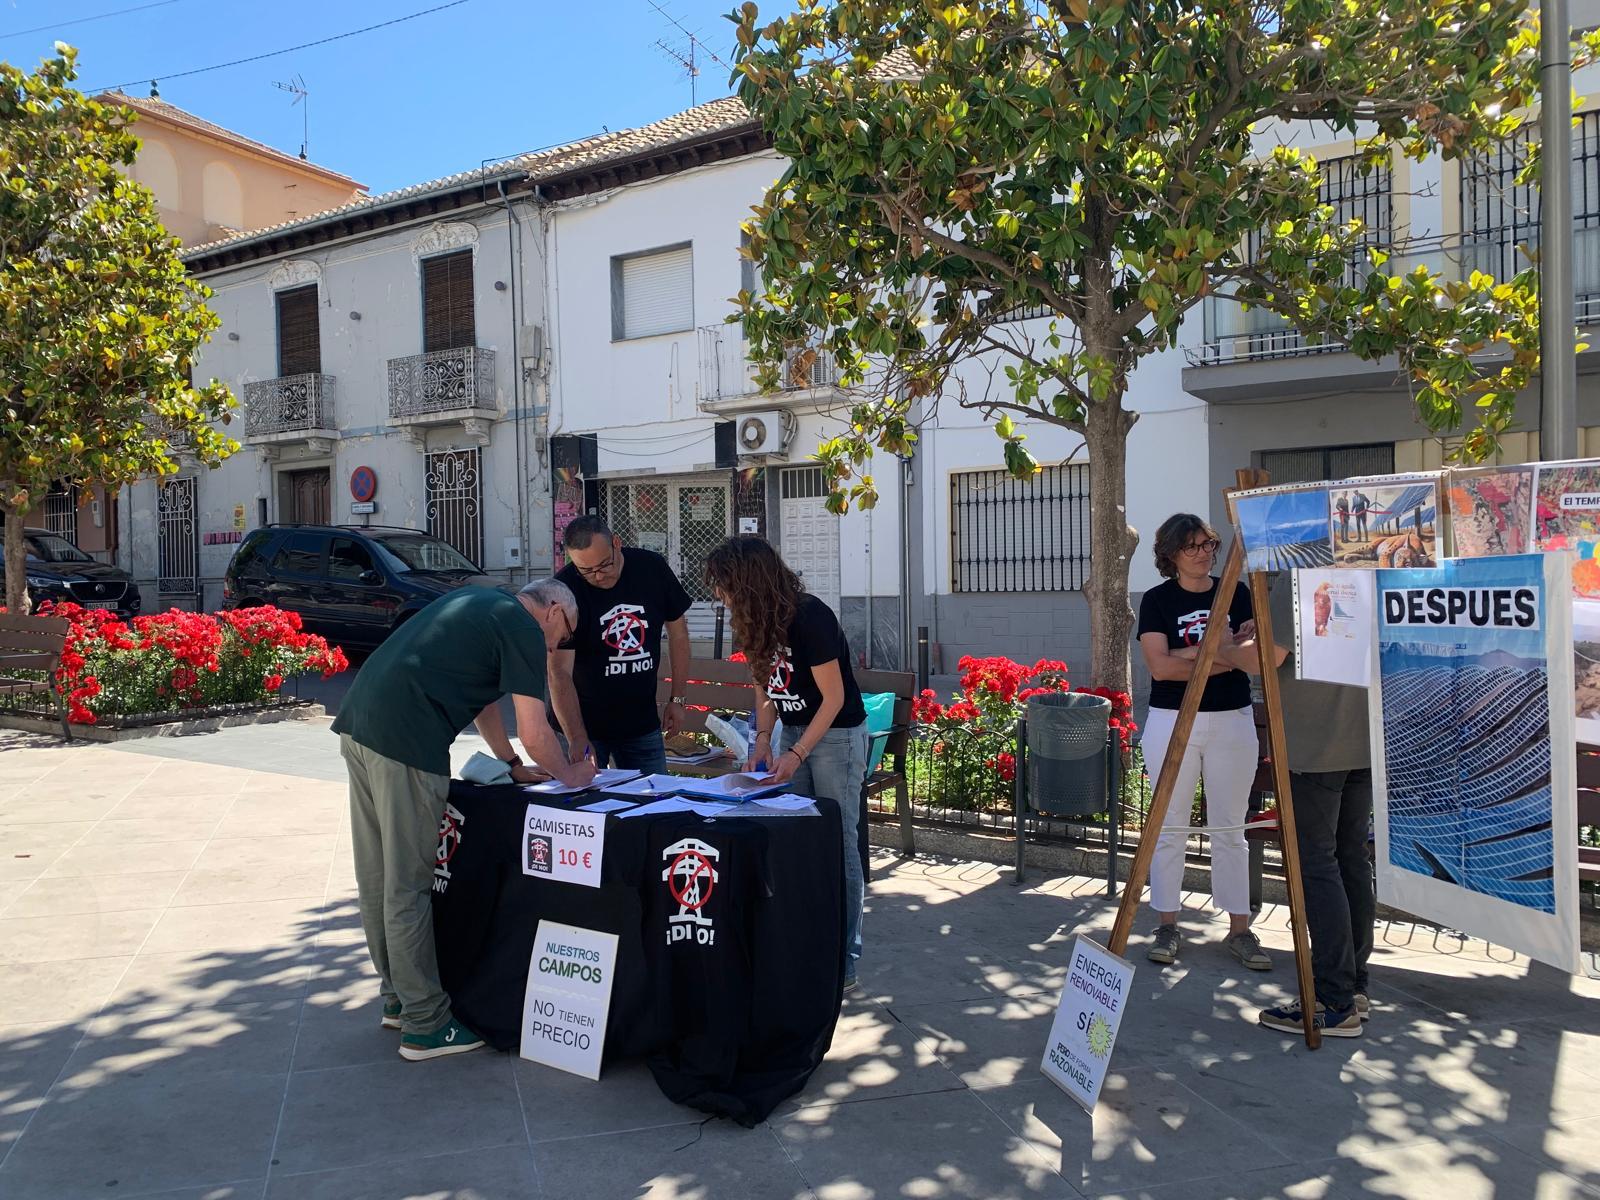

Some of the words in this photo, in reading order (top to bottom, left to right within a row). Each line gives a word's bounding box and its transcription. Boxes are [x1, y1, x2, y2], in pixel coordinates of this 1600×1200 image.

[1385, 588, 1536, 628] DESPUES
[605, 662, 627, 677] ¡DI
[631, 657, 653, 674] NO!
[782, 698, 807, 712] NO!
[528, 817, 595, 838] CAMISETAS
[559, 848, 578, 867] 10
[666, 924, 692, 946] ¡DI
[696, 927, 715, 946] O!
[546, 942, 600, 962] NUESTROS
[538, 957, 602, 984] CAMPOS
[1075, 953, 1122, 995] ENERGÍA
[1069, 972, 1118, 1013] RENOVABLE
[533, 999, 555, 1017] NO
[559, 1009, 595, 1028] TIENEN
[532, 1021, 590, 1051] PRECIO
[1057, 1042, 1071, 1058] PERO
[1049, 1048, 1094, 1094] RAZONABLE
